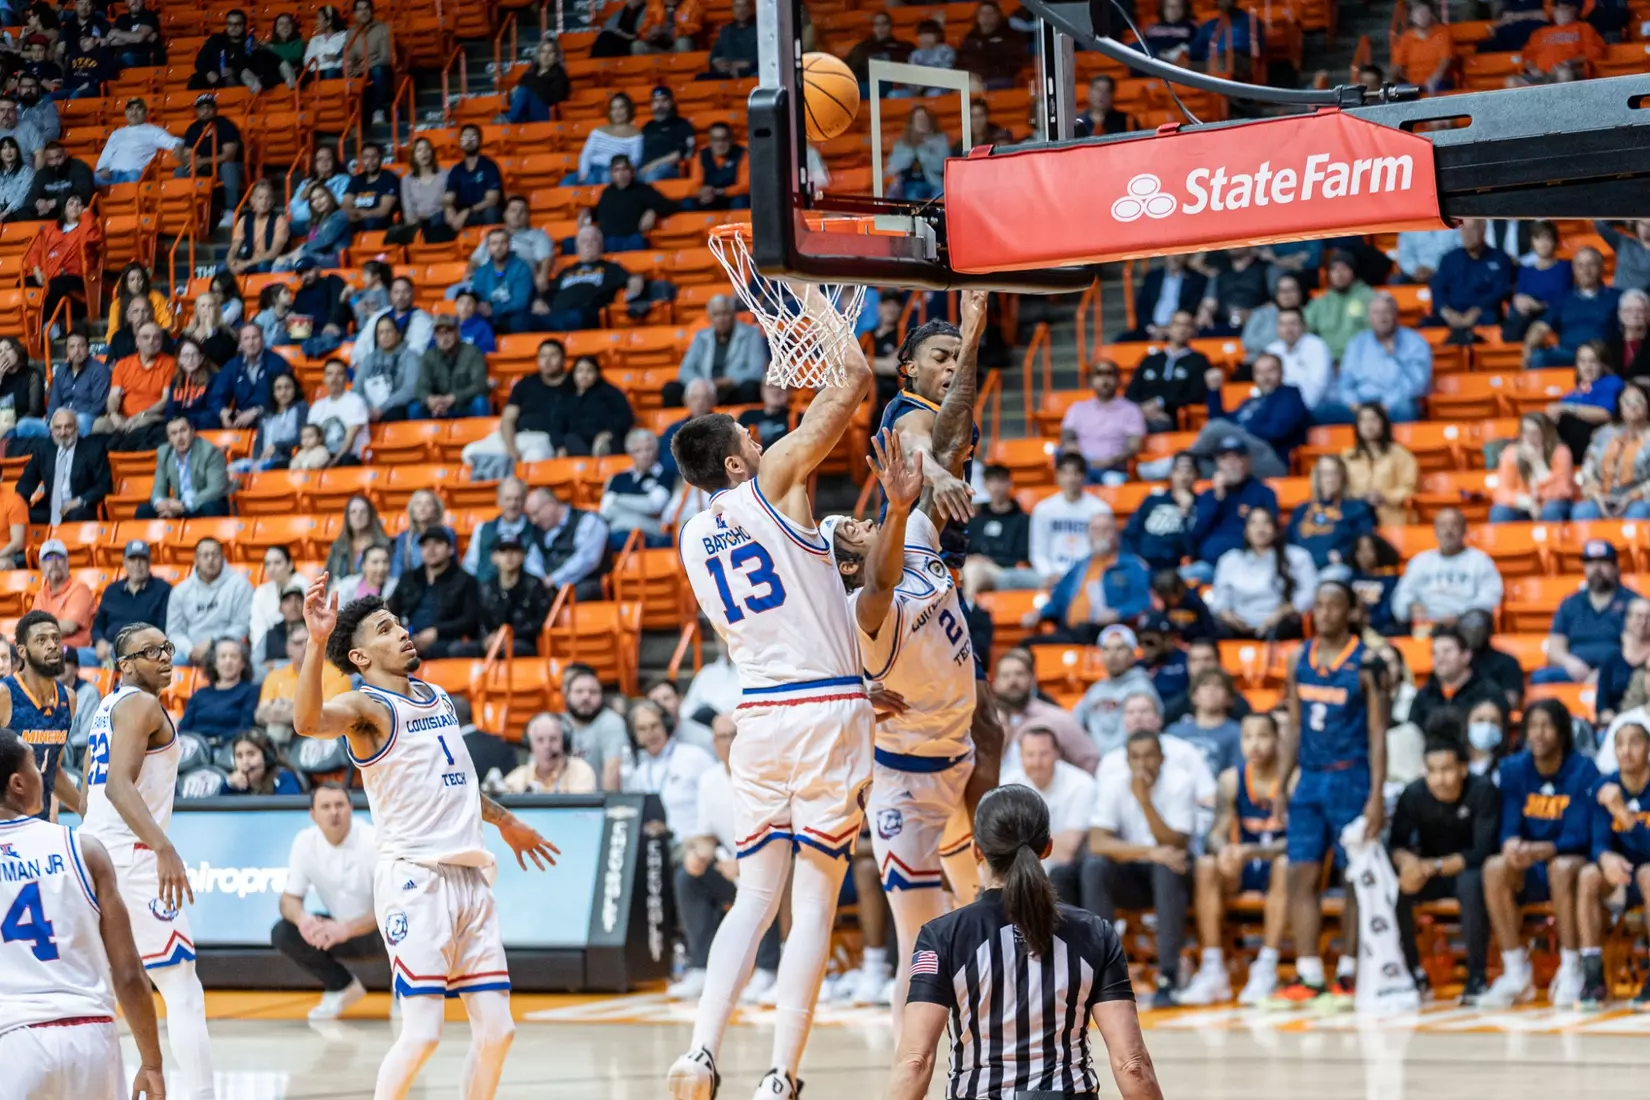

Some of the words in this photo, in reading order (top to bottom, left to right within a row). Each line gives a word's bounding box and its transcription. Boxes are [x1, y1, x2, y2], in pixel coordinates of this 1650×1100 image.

[702, 525, 752, 556] BATCHO
[704, 540, 787, 625] 13
[938, 608, 964, 648] 2
[21, 729, 68, 745] MINERS
[437, 735, 455, 766] 1
[0, 858, 41, 882] MAN
[45, 854, 65, 875] JR
[0, 881, 60, 962] 4
